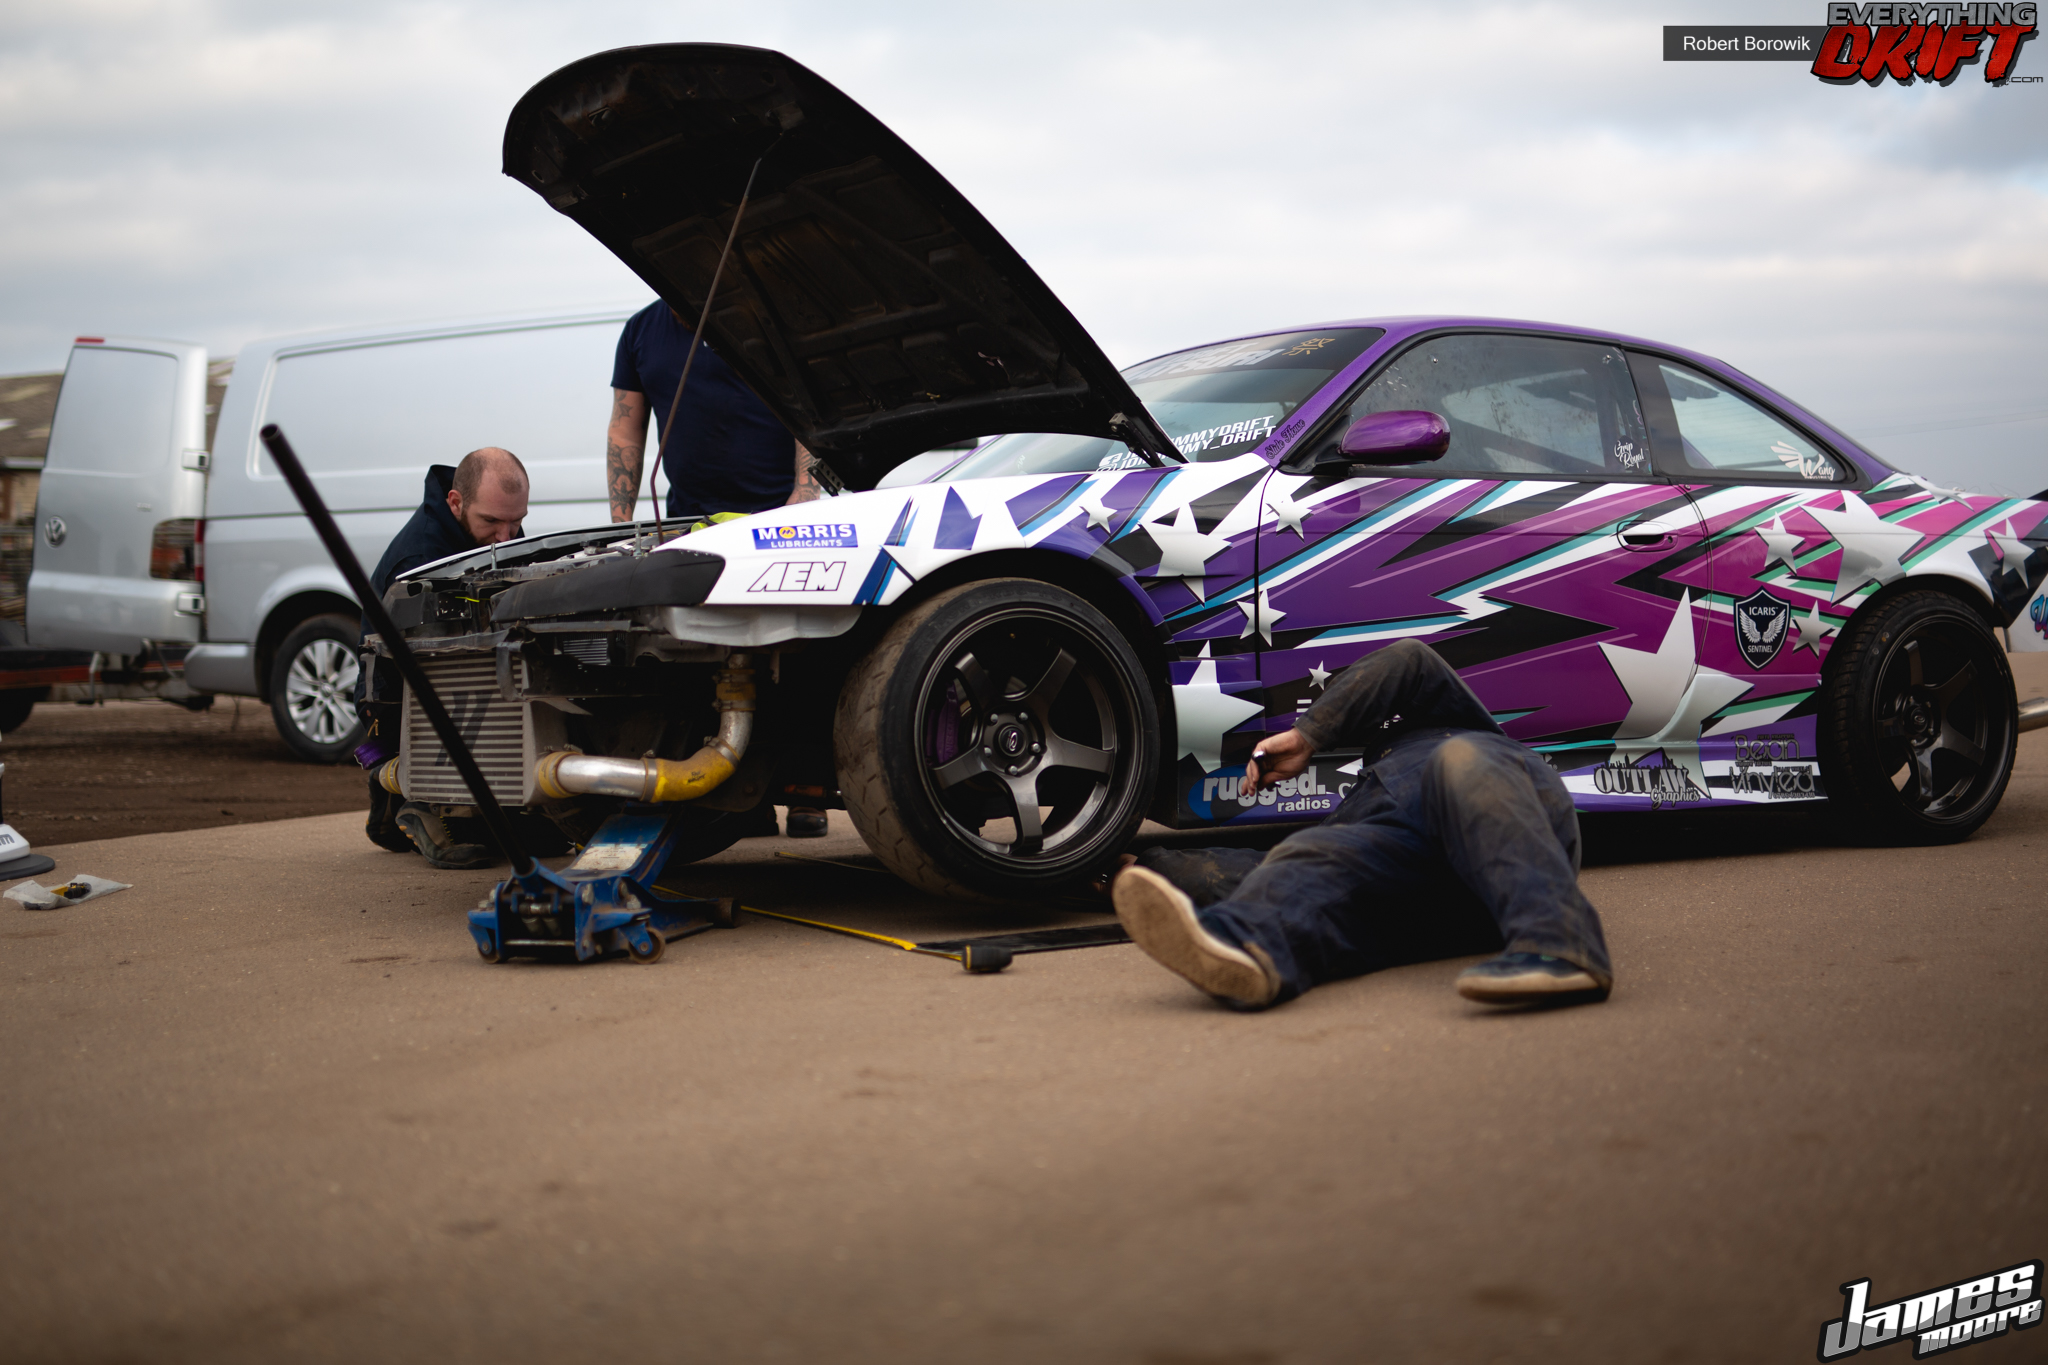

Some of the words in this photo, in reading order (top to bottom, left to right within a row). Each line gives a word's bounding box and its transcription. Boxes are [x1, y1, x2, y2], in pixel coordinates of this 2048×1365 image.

[1613, 440, 1634, 458] Grip
[1619, 448, 1645, 469] Royal
[757, 524, 853, 541] MORRIS
[770, 539, 843, 549] LUBRICANTS
[746, 561, 847, 592] AEM
[1748, 606, 1777, 616] ICARIS
[1747, 644, 1773, 653] SENTINEL
[1734, 734, 1801, 761] Bean
[1594, 767, 1689, 794] OUTLAW
[1277, 797, 1331, 813] radios
[1650, 785, 1701, 810] Graphics
